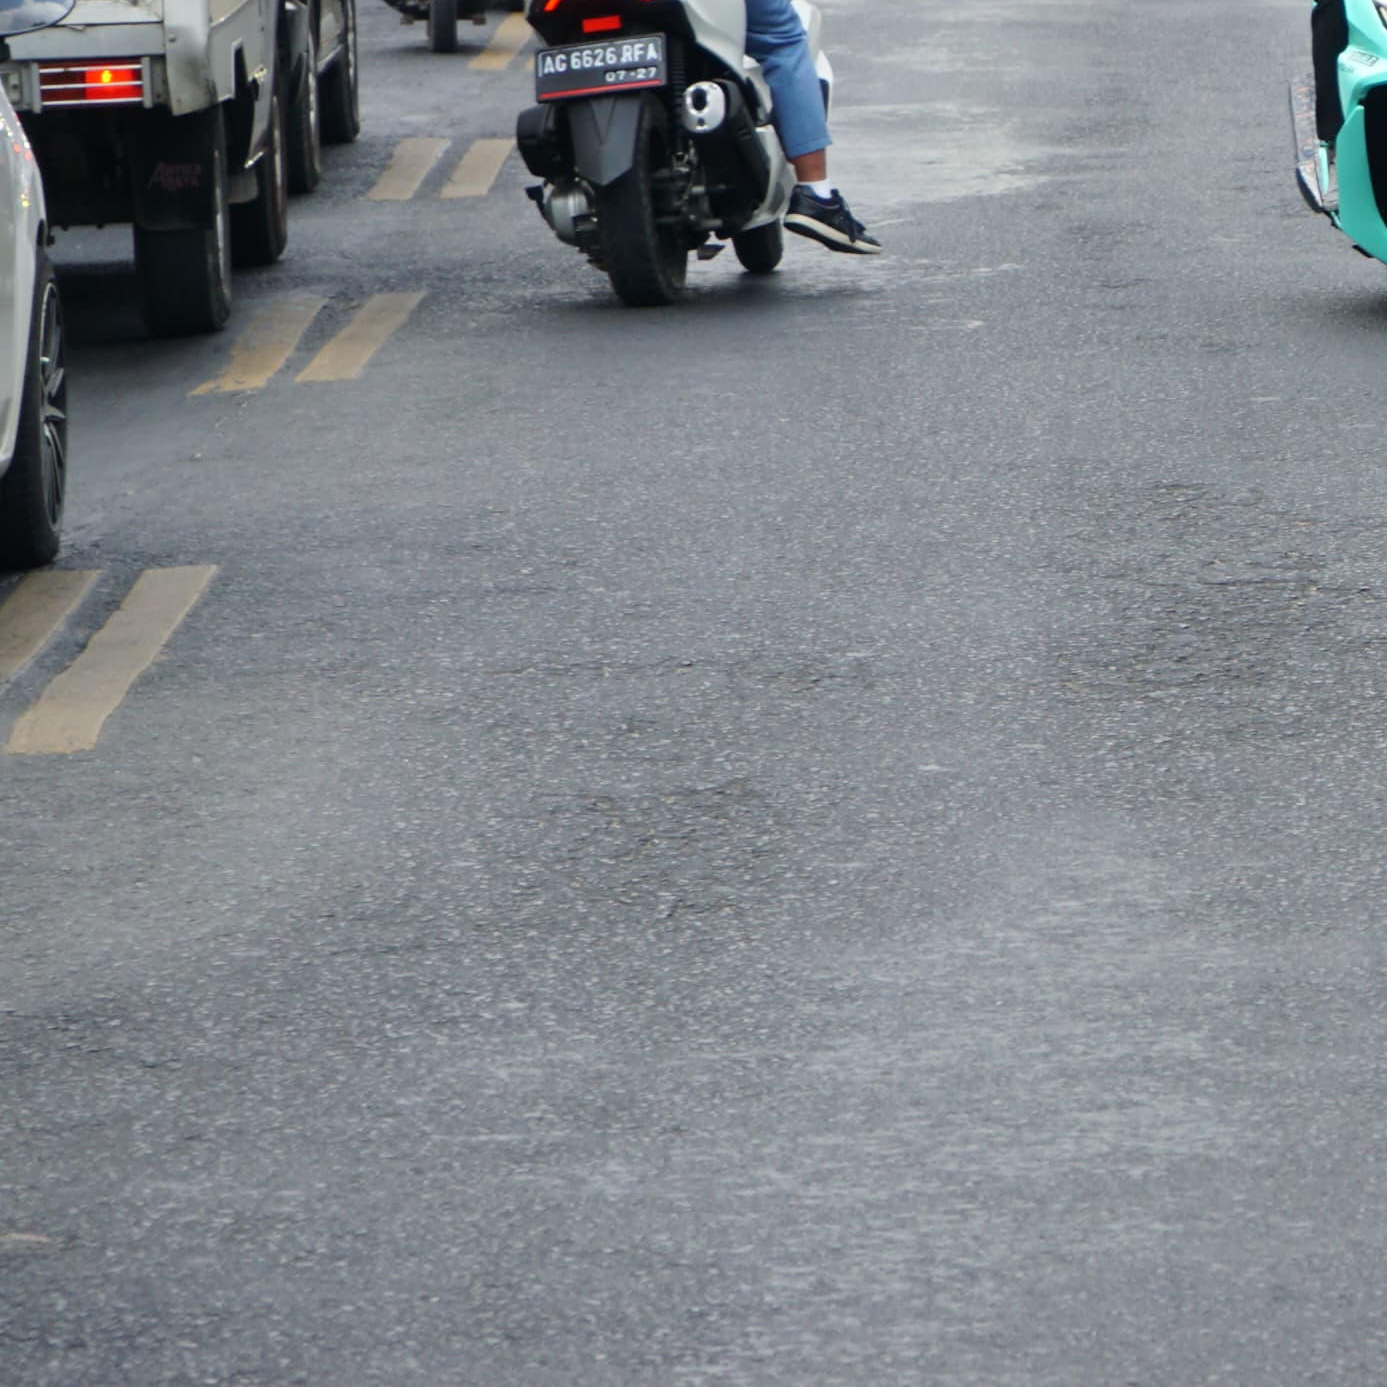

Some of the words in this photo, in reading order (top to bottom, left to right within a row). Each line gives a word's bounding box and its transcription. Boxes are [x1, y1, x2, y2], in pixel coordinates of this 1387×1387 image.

[543, 54, 567, 74] AG
[570, 47, 617, 70] 6626
[620, 43, 658, 63] RFA
[604, 67, 658, 83] 07-27
